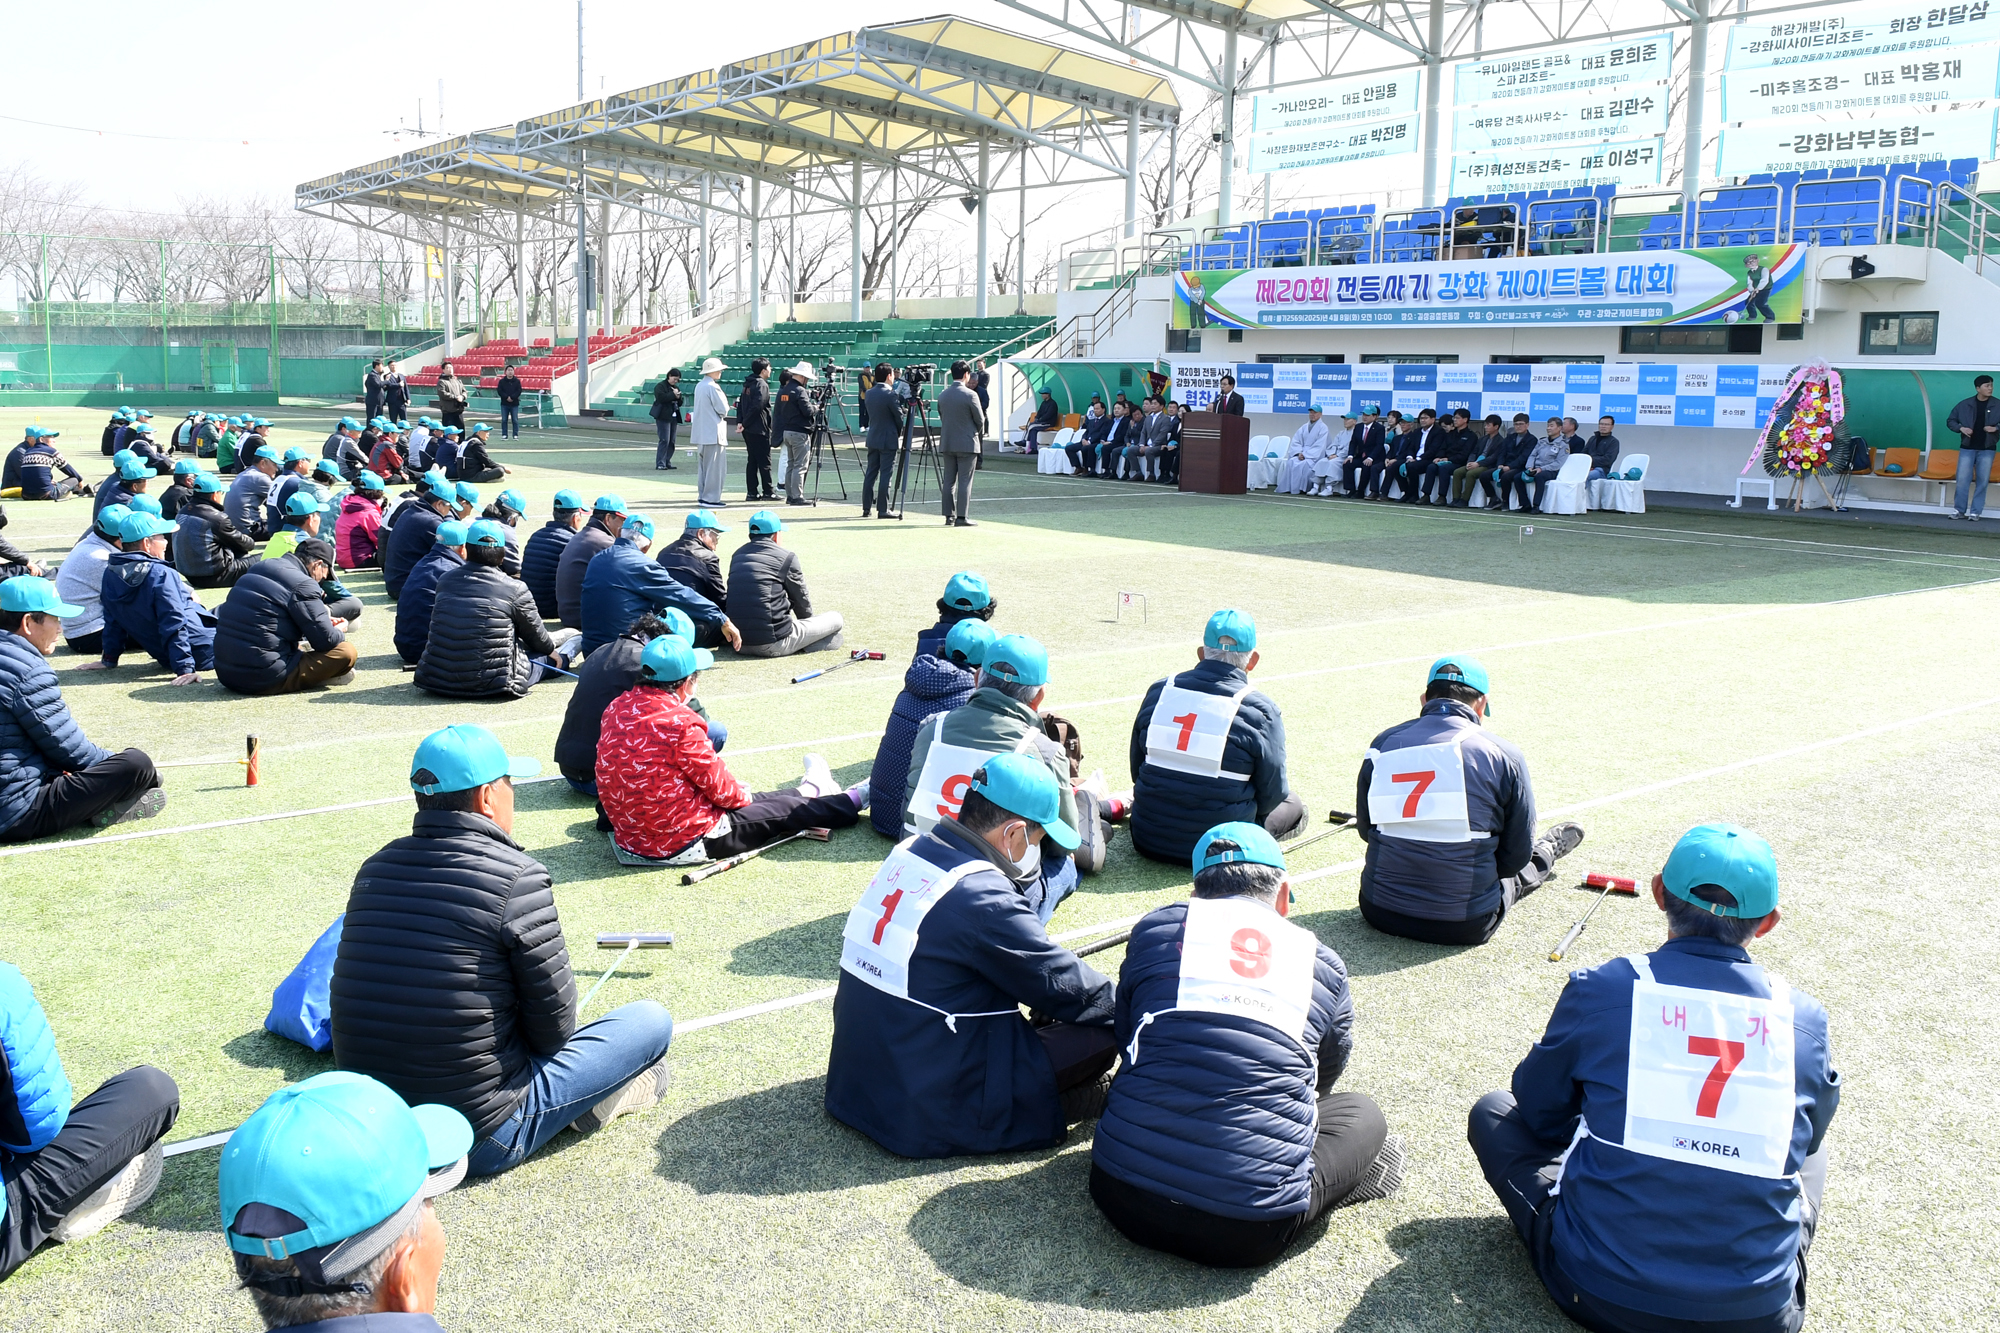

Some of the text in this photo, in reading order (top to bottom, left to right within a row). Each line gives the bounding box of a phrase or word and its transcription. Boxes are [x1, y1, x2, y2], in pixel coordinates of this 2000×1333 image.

[1771, 0, 1990, 37] 해강개발(주) 회장 한달삼
[1582, 55, 1605, 70] 대표
[1610, 43, 1656, 67] 윤희준
[1772, 56, 1799, 66] 제20회
[1800, 52, 1832, 62] 전등사기
[1882, 42, 1907, 52] 대회를
[1497, 75, 1516, 87] 스파
[1864, 70, 1895, 86] 대표
[1900, 60, 1961, 82] 박홍재
[1342, 92, 1360, 105] 대표
[1364, 83, 1397, 102] 안필용
[1492, 89, 1512, 99] 제20회
[1514, 86, 1538, 96] 전등사기
[1577, 79, 1596, 88] 대회를
[1581, 106, 1604, 120] 대표
[1609, 97, 1654, 117] 김관수
[1772, 104, 1798, 115] 제20회
[1801, 101, 1832, 112] 전등사기
[1883, 94, 1906, 104] 대회를
[1349, 134, 1367, 147] 대표
[1371, 124, 1406, 142] 박진명
[1491, 138, 1512, 147] 제20회
[1578, 128, 1596, 138] 대회를
[1580, 155, 1604, 169] 대표
[1608, 147, 1653, 166] 이성구
[1765, 162, 1792, 171] 제20회
[1794, 161, 1826, 171] 전등사기
[1255, 263, 1675, 304] 제20회 전등사기 강화 게이트볼 대회
[1597, 308, 1663, 318] 강화군게이트볼협회
[1178, 368, 1232, 377] 제20회 전등사기
[1496, 374, 1519, 382] 협찬사
[1447, 401, 1469, 410] 협찬사
[270, 483, 278, 497] 2
[1123, 594, 1130, 603] 3
[1172, 712, 1198, 752] 1
[1391, 770, 1436, 818] 7
[872, 888, 904, 946] 1
[1229, 927, 1272, 979] 9
[861, 958, 882, 978] KOREA
[1234, 995, 1275, 1013] KOREA
[1688, 1035, 1745, 1119] 7
[1690, 1139, 1741, 1158] KOREA
